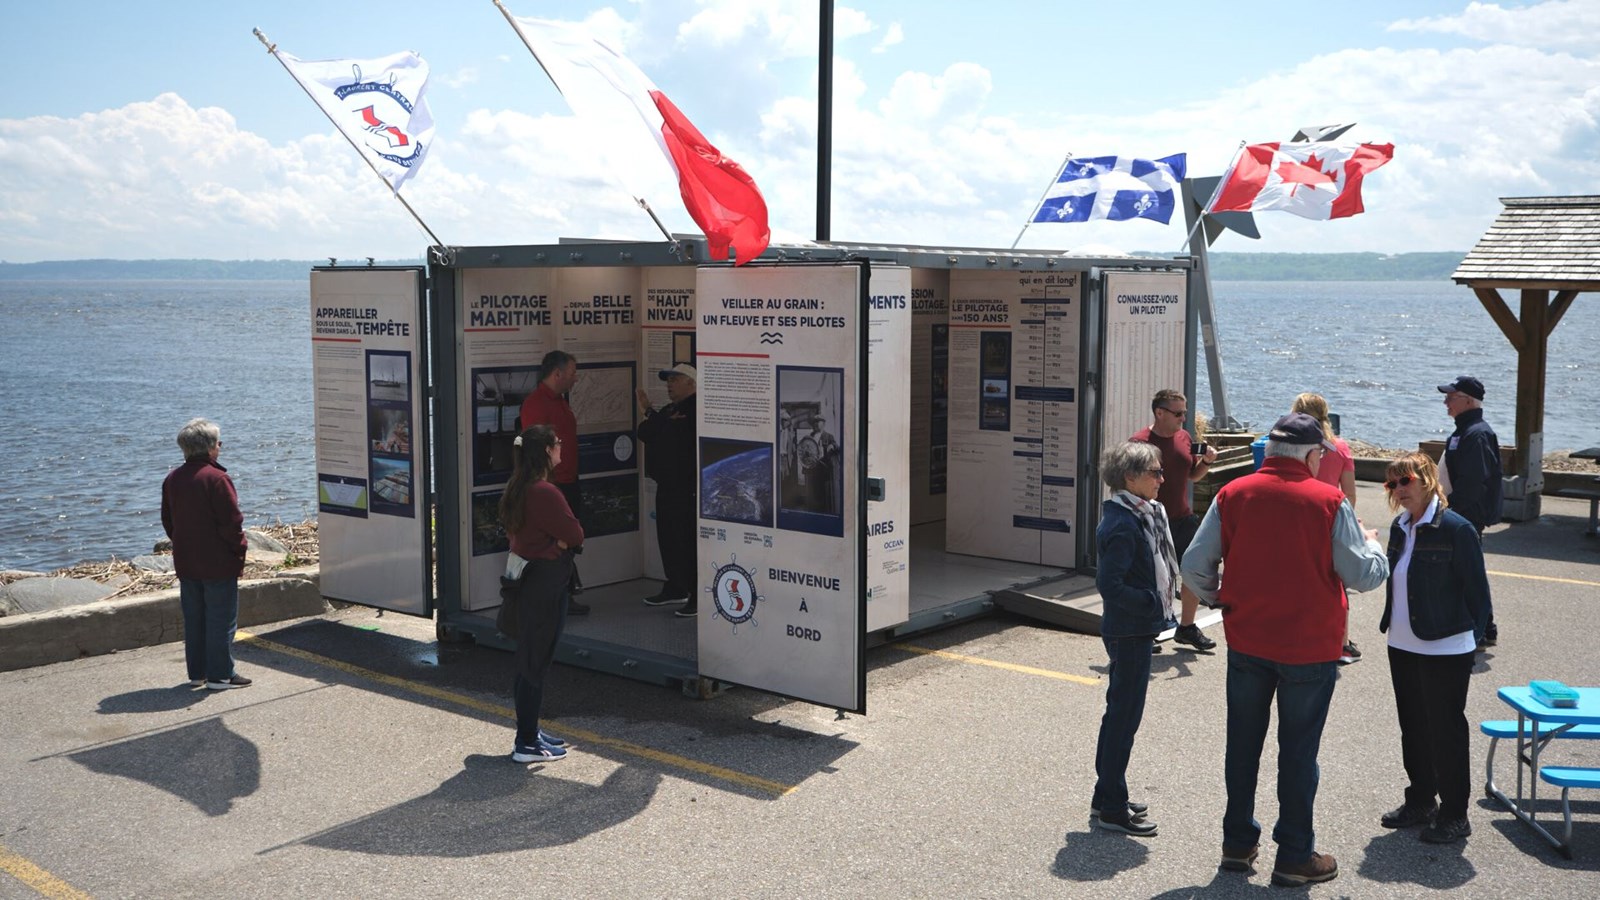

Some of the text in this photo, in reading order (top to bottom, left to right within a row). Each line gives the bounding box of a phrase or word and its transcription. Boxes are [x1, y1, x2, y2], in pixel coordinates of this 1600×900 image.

[1020, 276, 1030, 286] qui
[480, 295, 547, 308] PILOTAGE
[593, 295, 631, 308] BELLE
[656, 295, 689, 307] HAUT
[722, 299, 763, 309] VEILLER
[766, 299, 782, 309] AU
[784, 299, 818, 310] GRAIN
[868, 295, 906, 309] MENTS
[1117, 295, 1178, 304] CONNAISSEZ-VOUS
[316, 308, 377, 319] APPAREILLER
[648, 308, 693, 321] NIVEAU
[1130, 306, 1166, 314] UN PILOTE?
[471, 310, 551, 326] MARITIME
[564, 310, 634, 325] LURETTE!
[703, 315, 845, 328] UN FLEUVE ET SES PILOTES
[963, 314, 979, 322] 150
[982, 314, 1008, 322] ANS?
[356, 319, 410, 336] TEMPÊTE
[866, 520, 894, 537] AIRES
[769, 568, 840, 591] BIENVENUE
[799, 598, 808, 613] À
[787, 624, 821, 642] BORD
